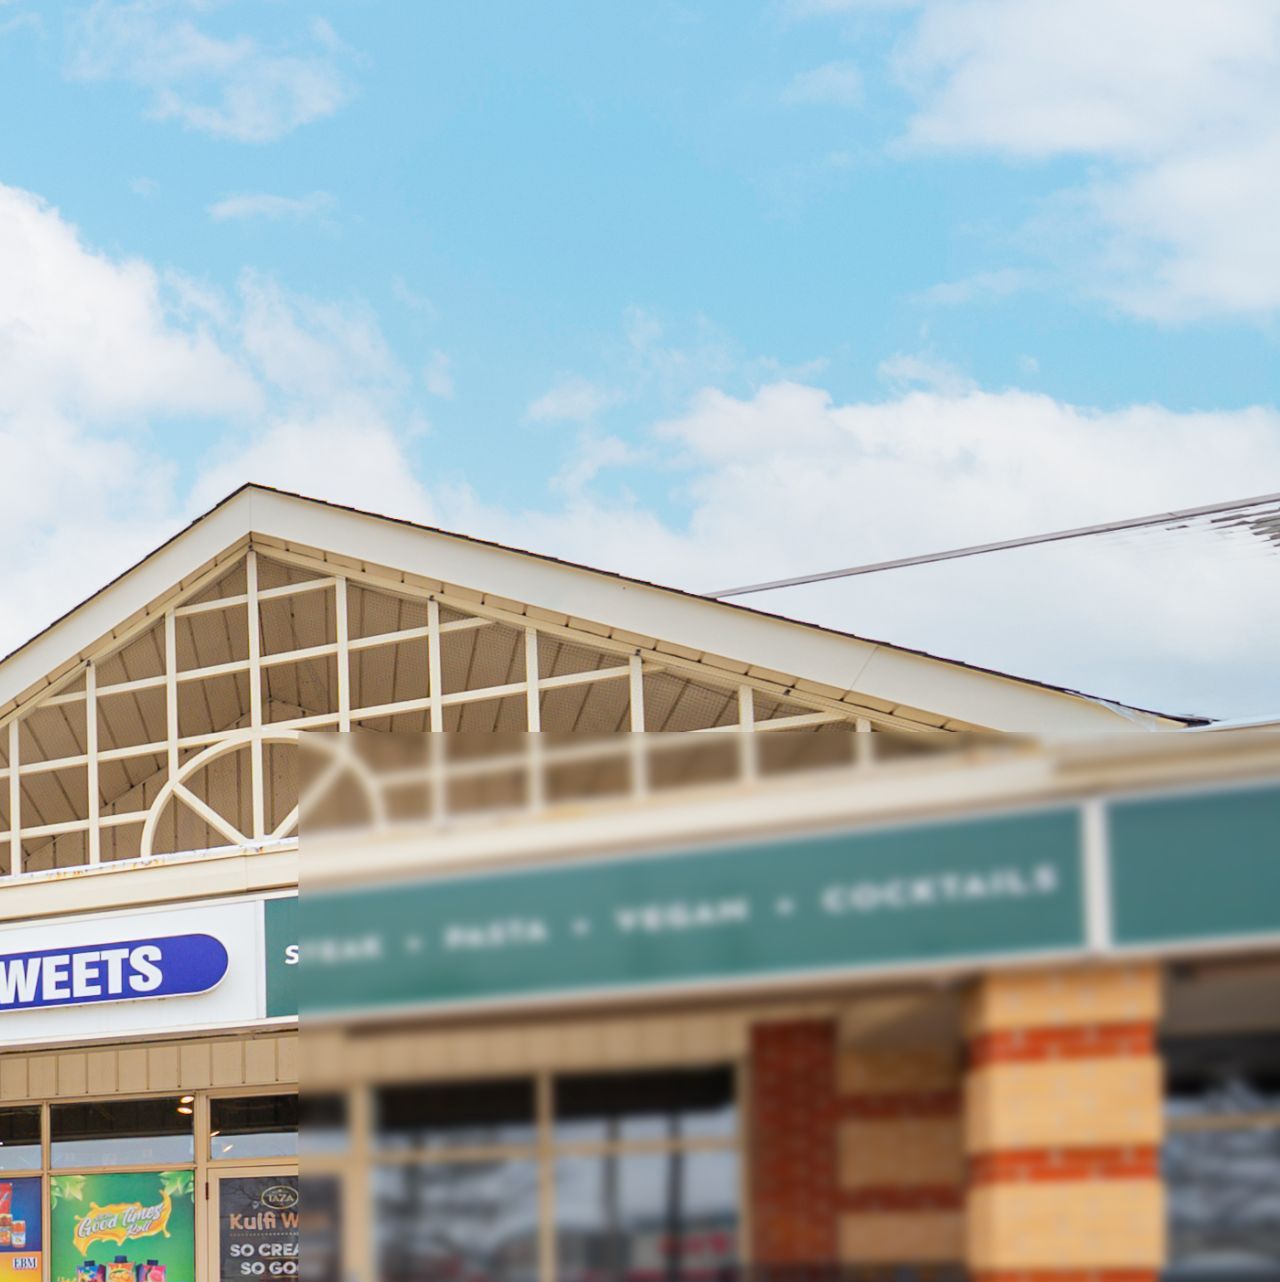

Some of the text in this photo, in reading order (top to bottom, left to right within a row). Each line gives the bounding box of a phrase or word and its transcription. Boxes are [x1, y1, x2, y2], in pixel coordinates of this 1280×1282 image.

[78, 1202, 164, 1238] Good Times
[229, 1211, 276, 1230] Kulfi
[230, 1243, 255, 1257] SO
[14, 1258, 37, 1268] EBM
[241, 1261, 299, 1275] SO GO
